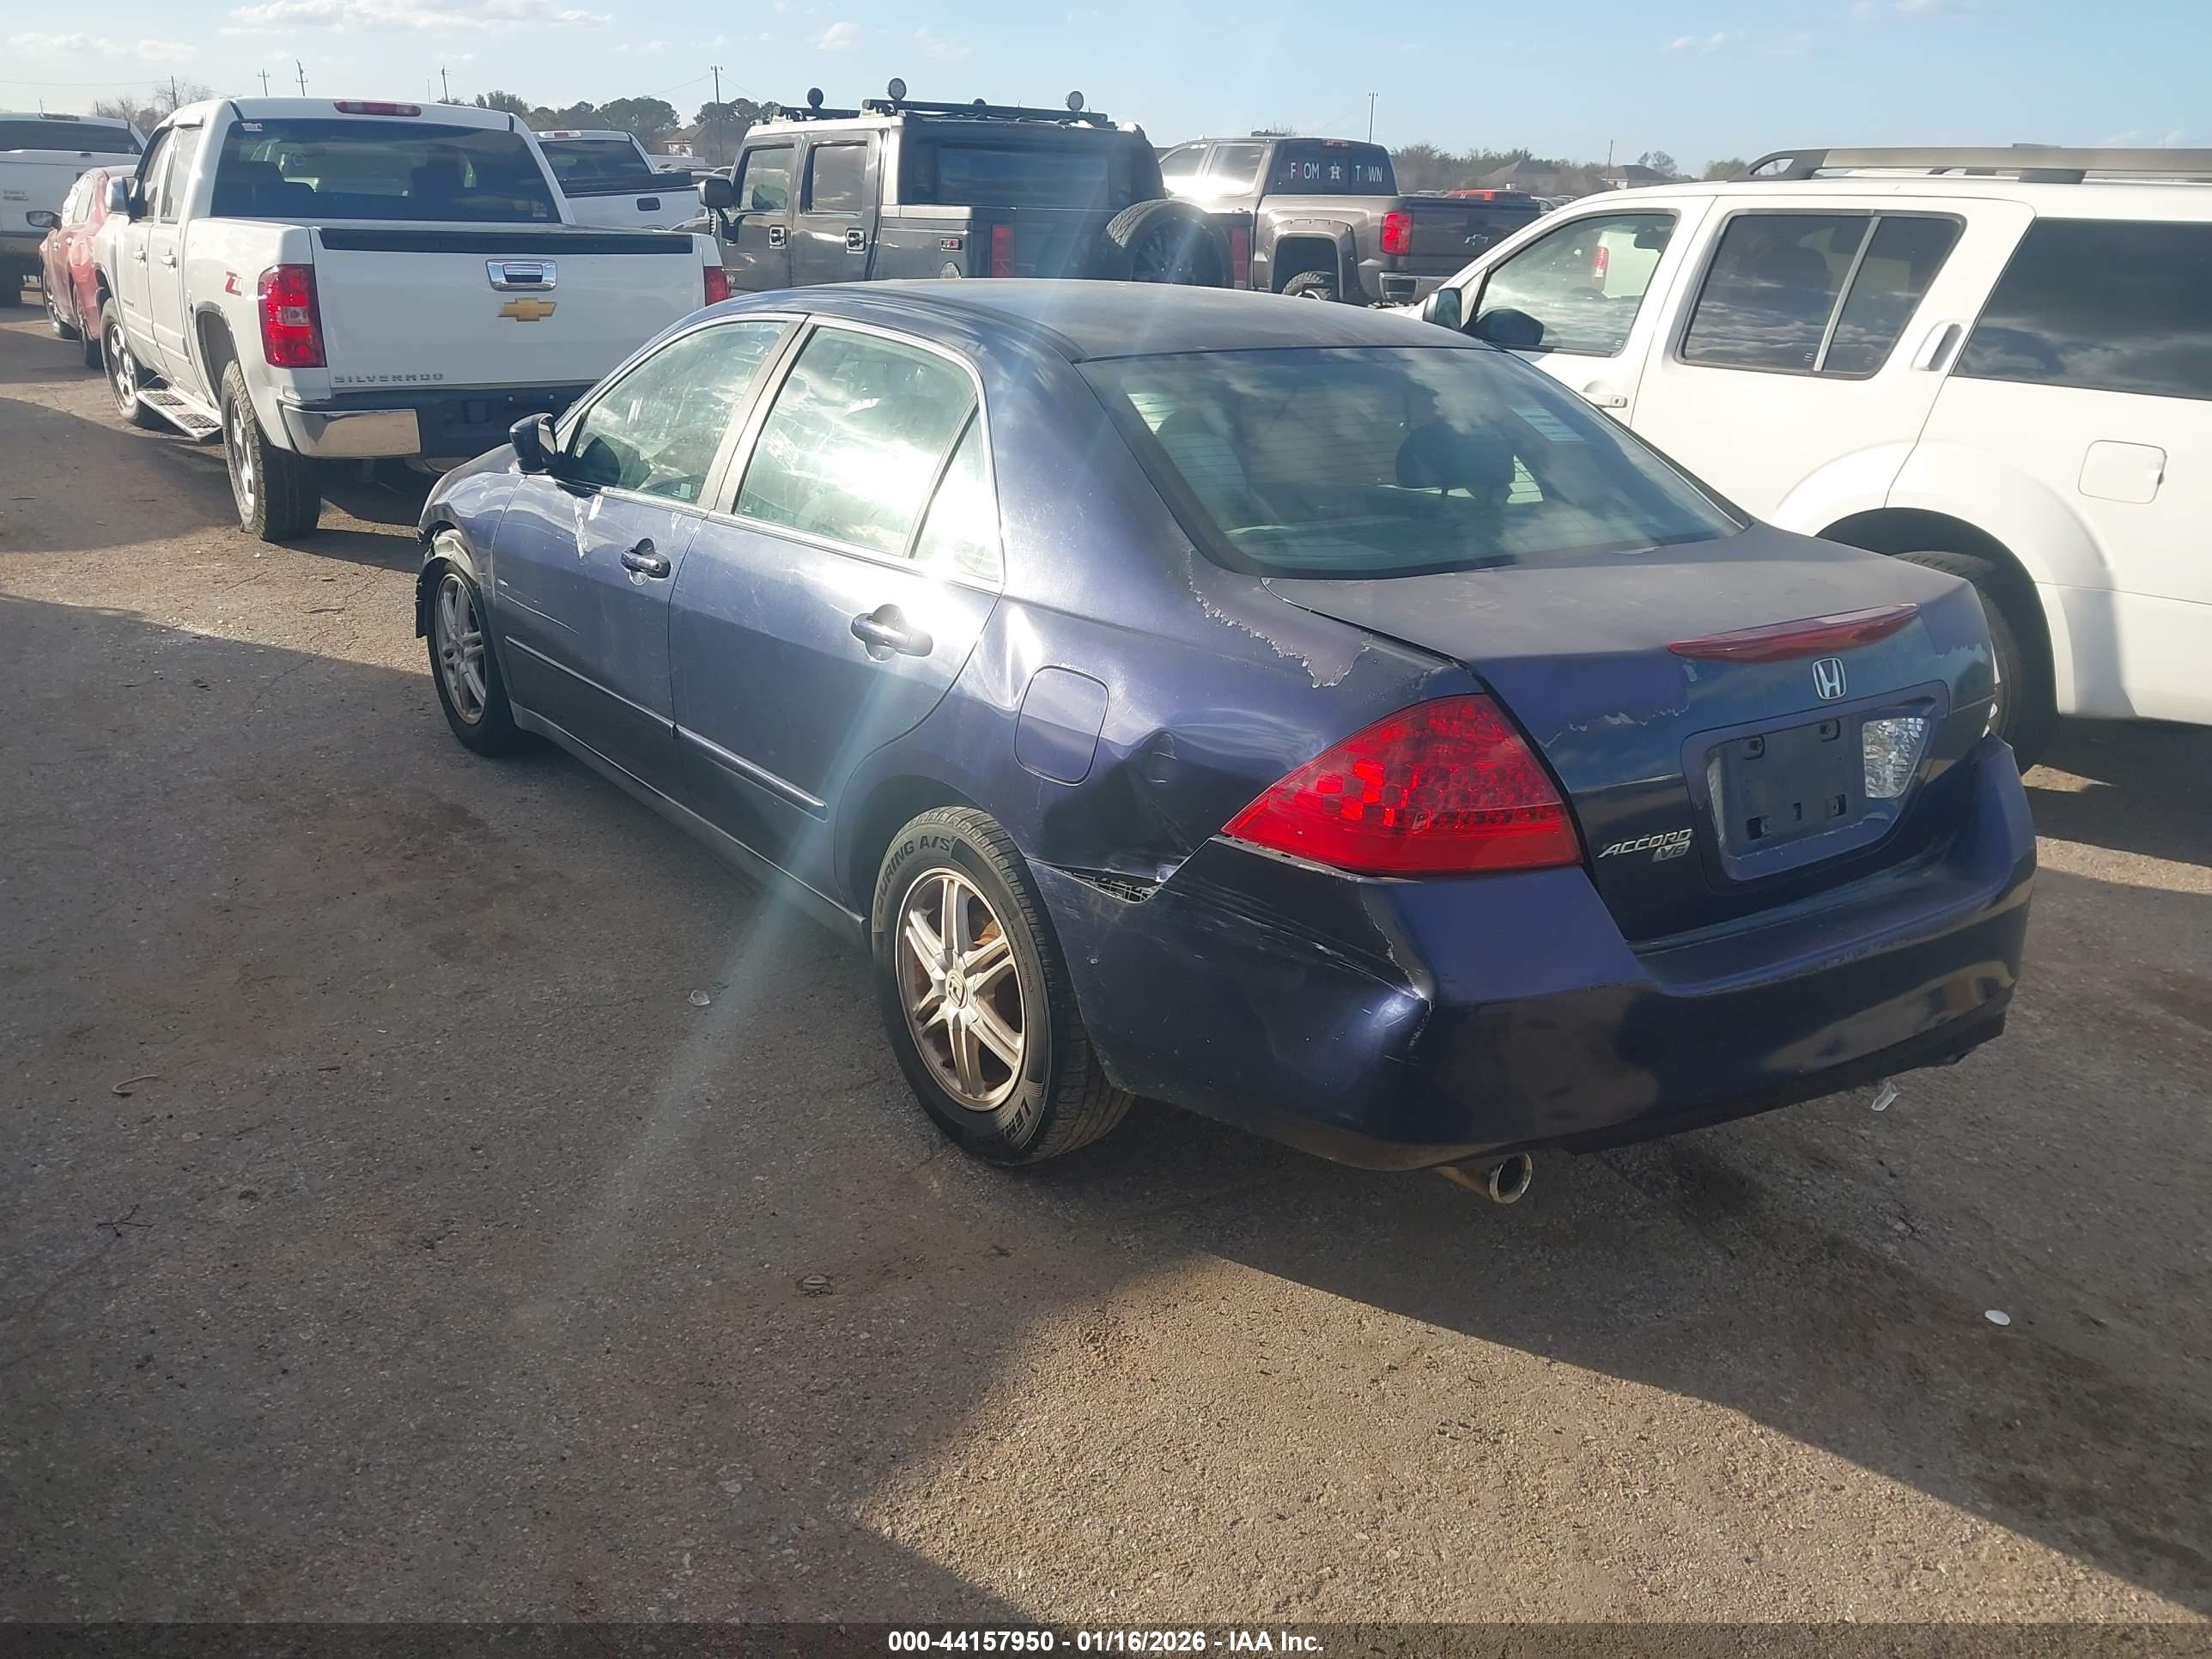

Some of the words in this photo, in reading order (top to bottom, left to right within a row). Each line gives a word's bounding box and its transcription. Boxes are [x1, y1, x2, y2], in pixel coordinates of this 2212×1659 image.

[1355, 164, 1383, 183] TWN
[334, 373, 444, 383] SILVERADO
[1597, 828, 1692, 859] ACCORD
[1655, 841, 1691, 861] V6
